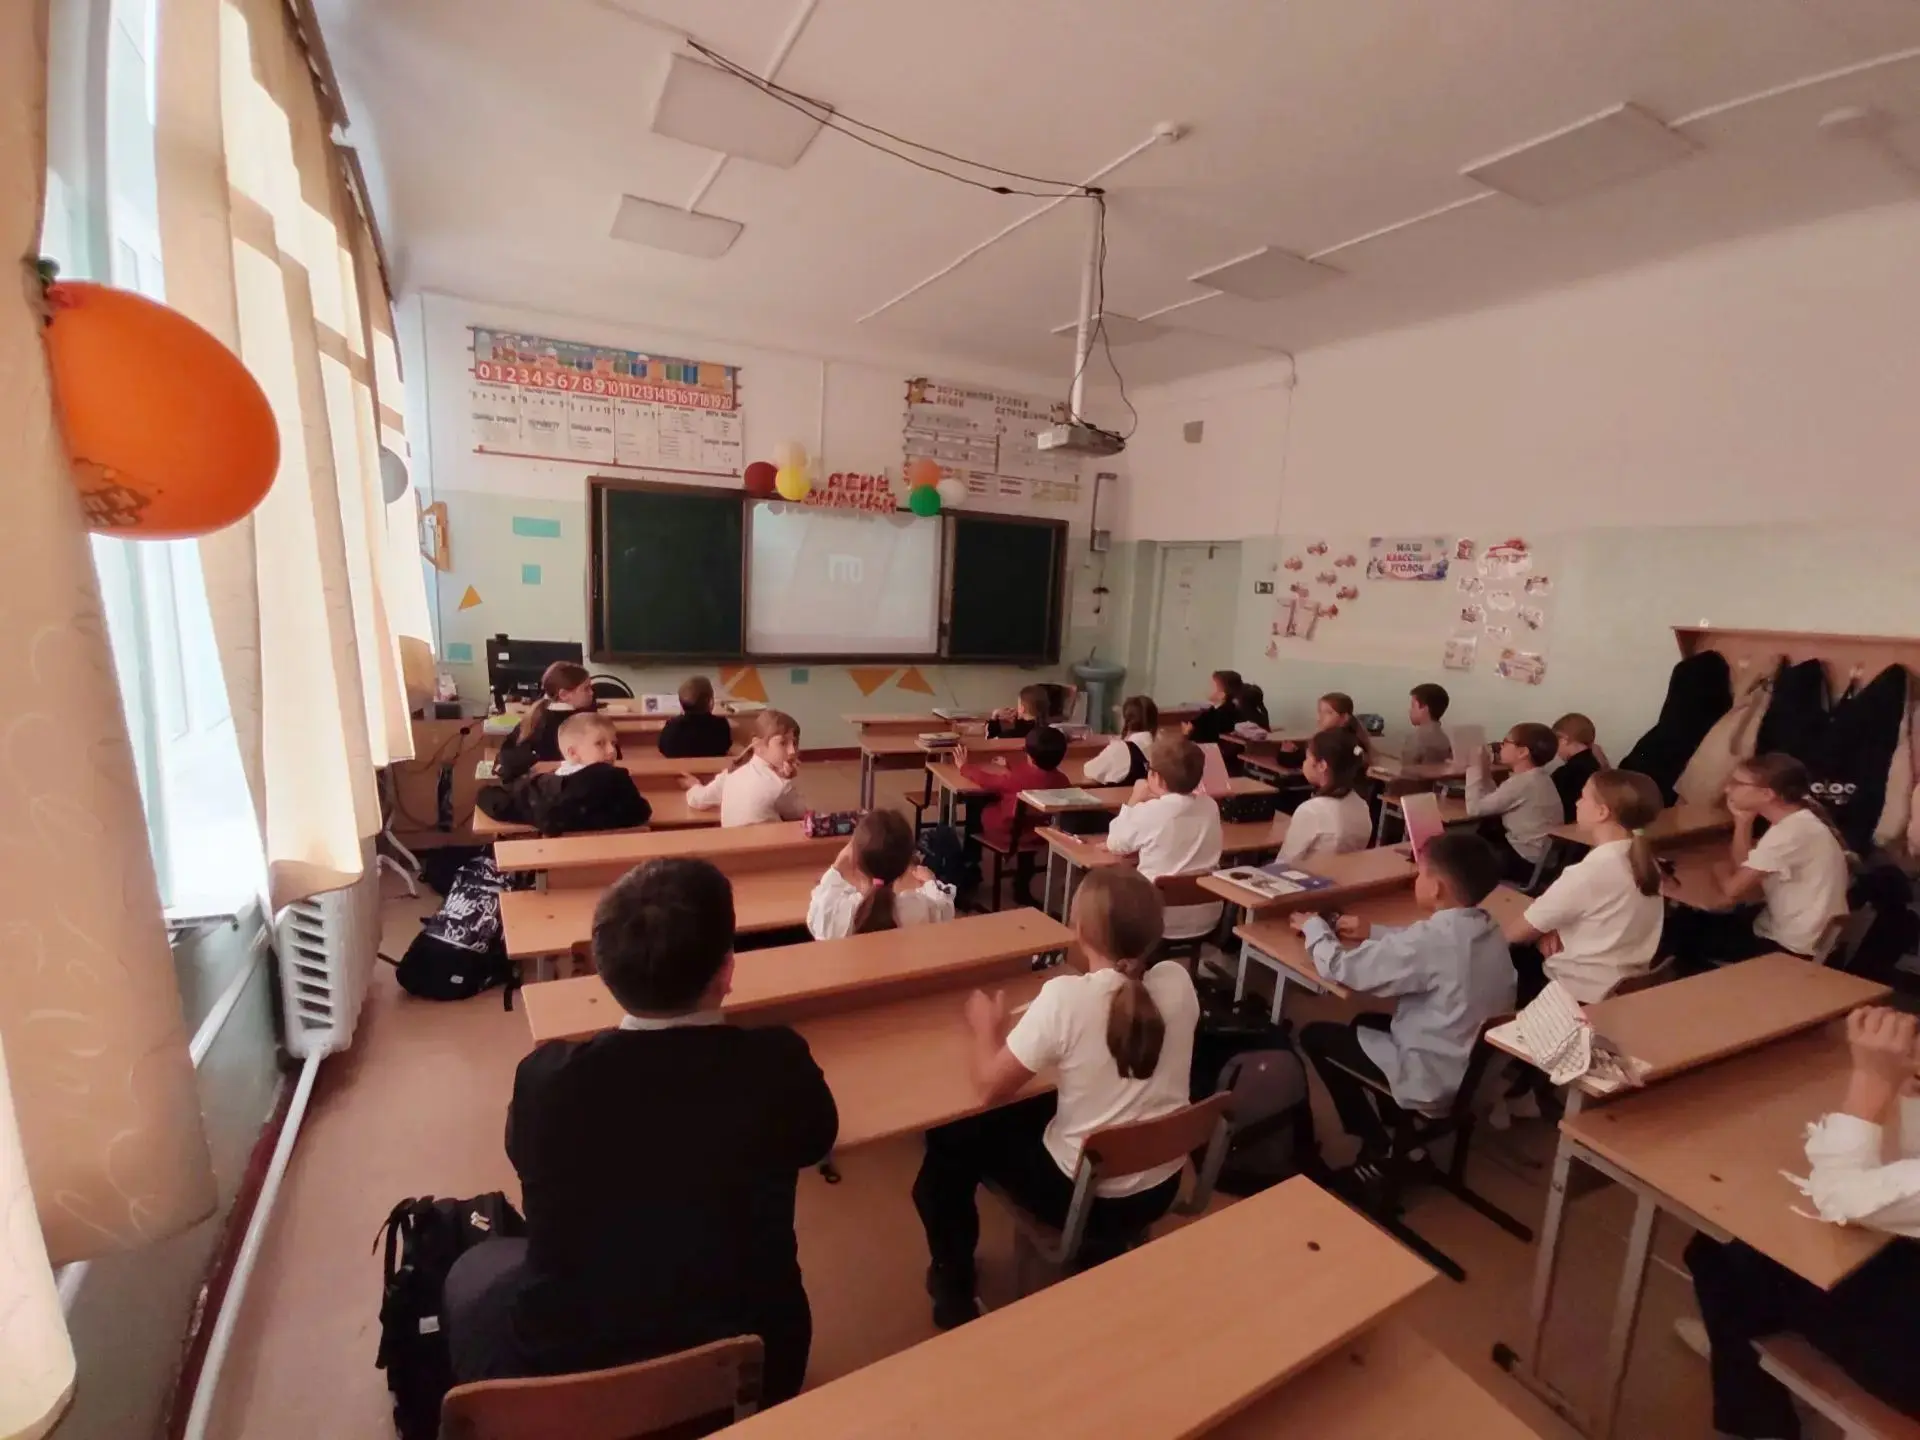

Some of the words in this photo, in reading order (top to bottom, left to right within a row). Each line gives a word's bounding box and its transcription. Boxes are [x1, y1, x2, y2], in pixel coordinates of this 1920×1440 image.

[480, 363, 490, 378] 0
[494, 366, 502, 380] 1
[506, 367, 517, 382] 2
[520, 368, 530, 384] 3
[532, 370, 542, 386] 4
[546, 372, 556, 387] 5
[558, 374, 568, 389] 6
[571, 376, 580, 390] 7
[582, 377, 592, 392] 8
[595, 379, 605, 394] 9
[606, 380, 618, 395] 10
[620, 382, 630, 397] 11
[631, 384, 642, 398] 12
[644, 386, 654, 400] 13
[655, 387, 665, 401] 14
[666, 388, 677, 402] 15
[678, 390, 688, 404] 16
[688, 391, 699, 405] 17
[827, 472, 889, 493] ДЕНЬ
[1397, 544, 1422, 552] НАШ
